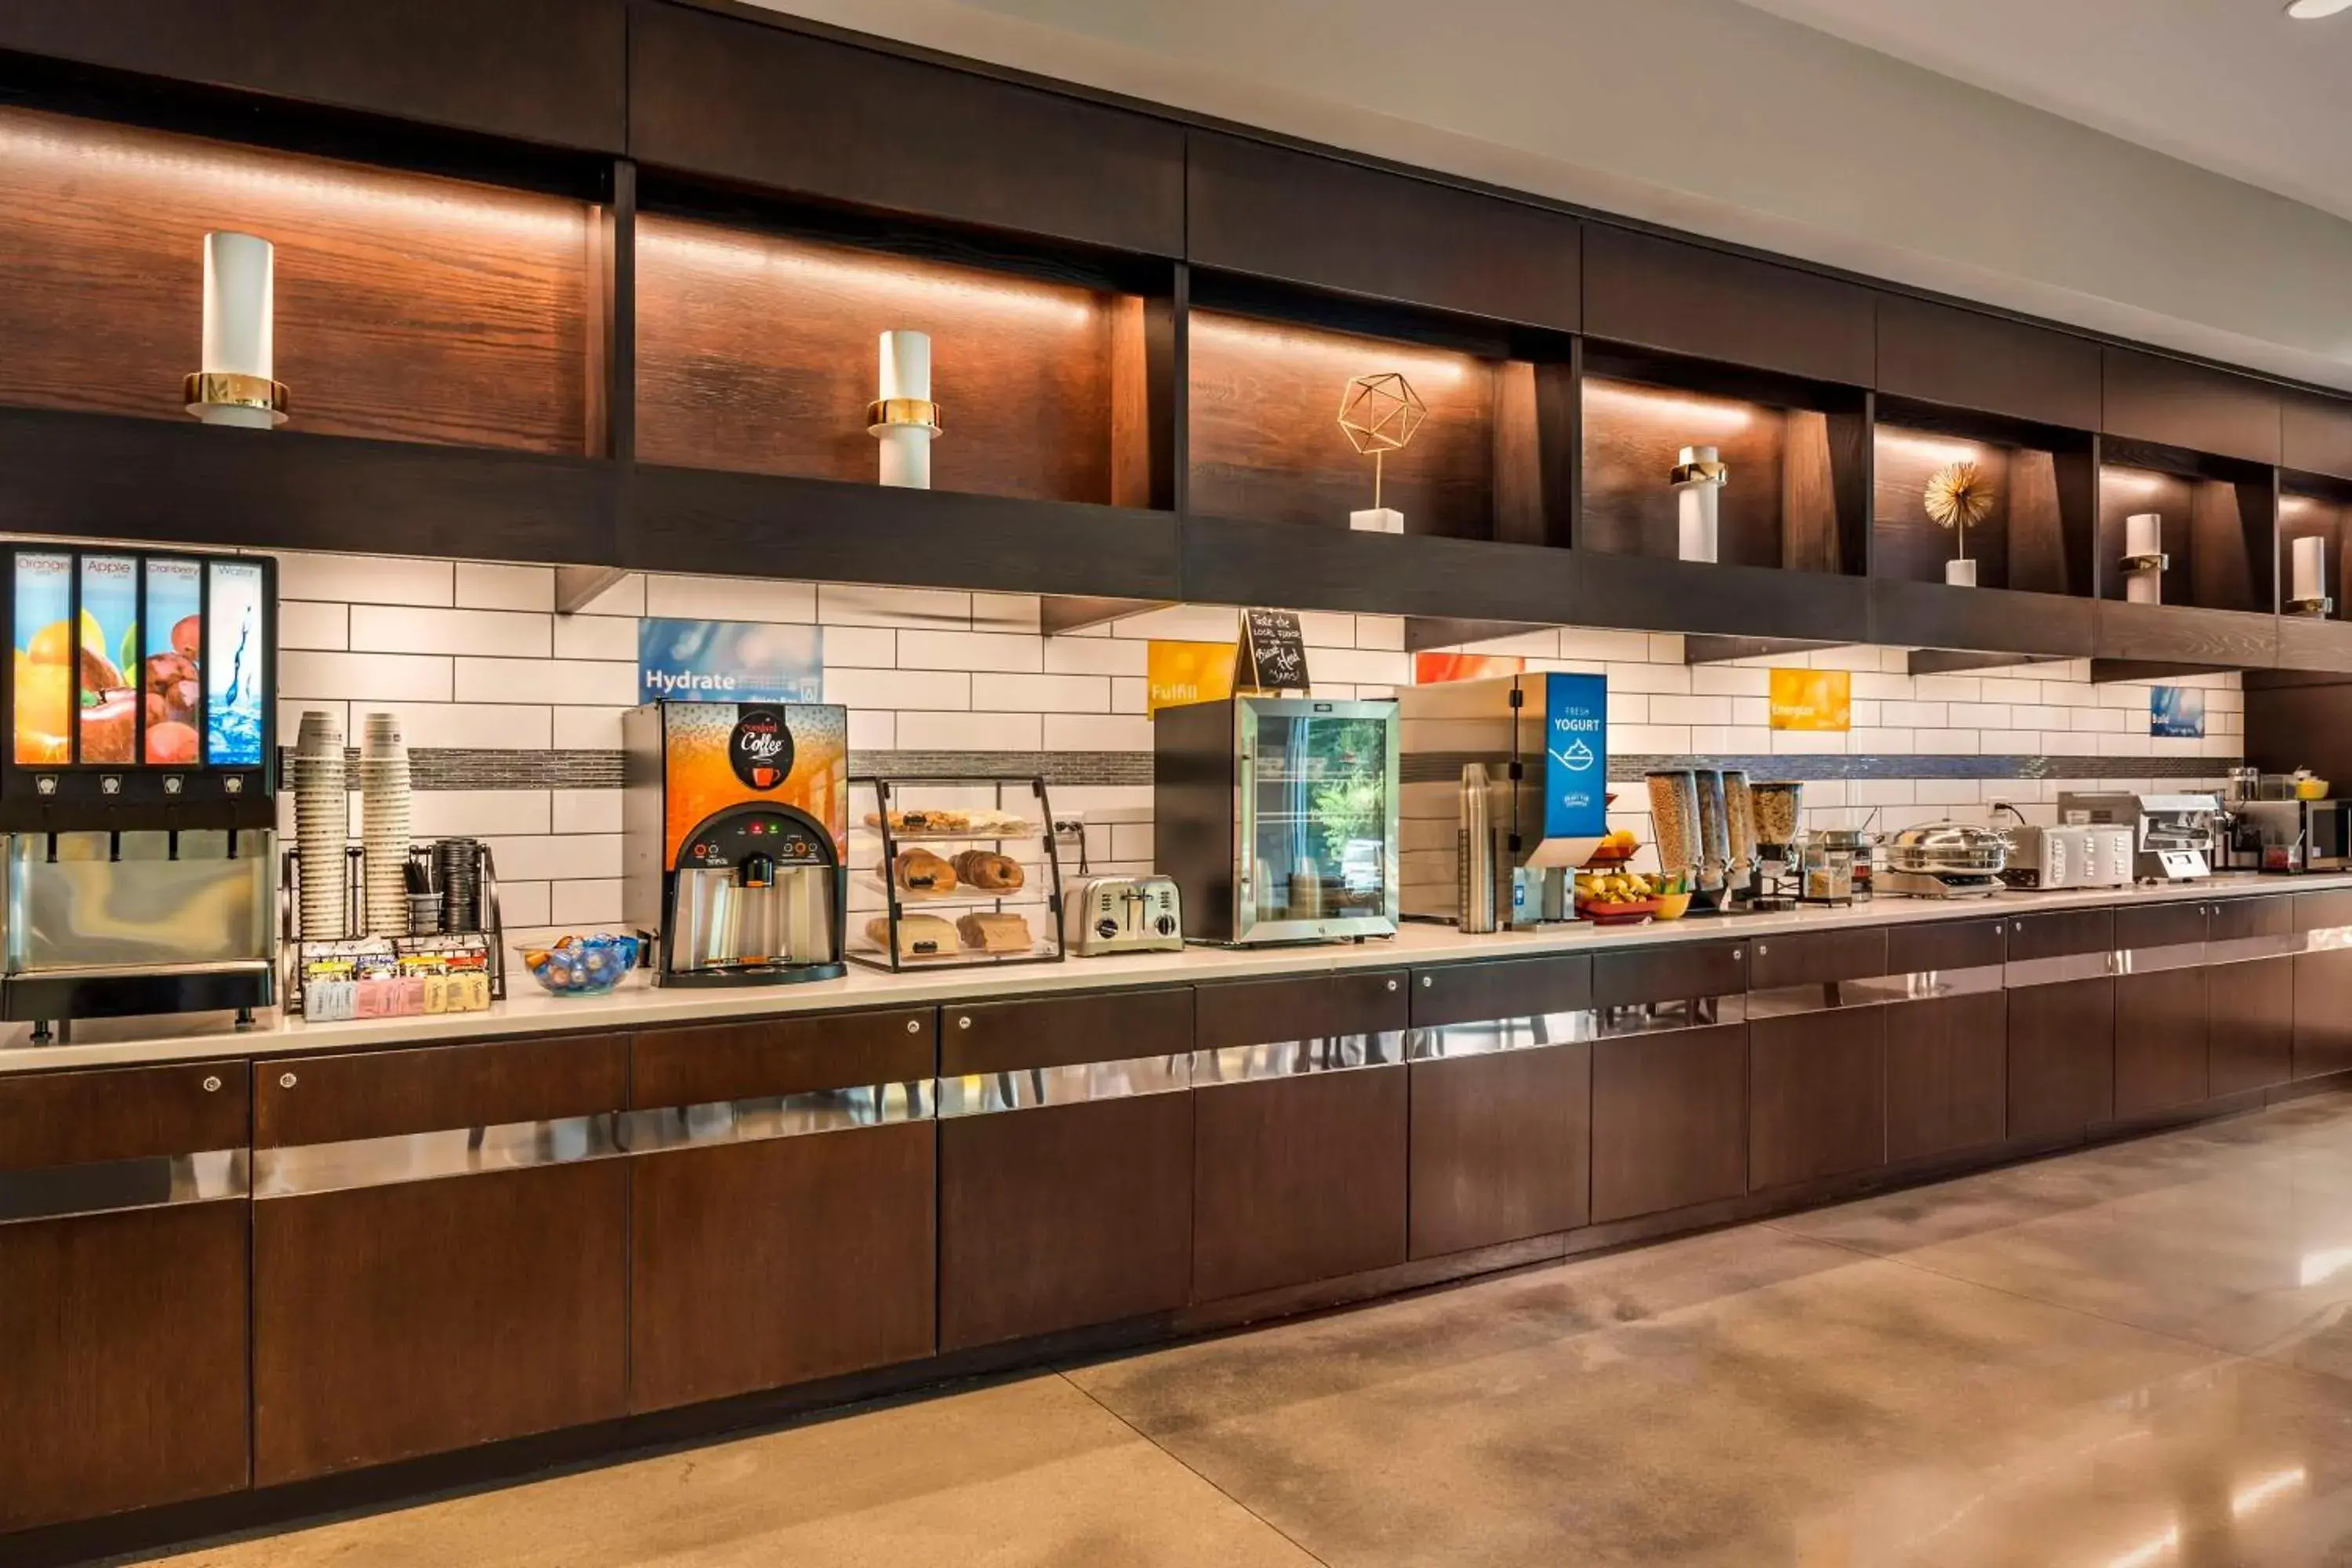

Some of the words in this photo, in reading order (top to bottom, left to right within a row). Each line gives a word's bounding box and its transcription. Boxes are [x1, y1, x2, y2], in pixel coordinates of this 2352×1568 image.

[88, 560, 131, 574] Apple
[645, 669, 735, 693] Hydrate
[1152, 684, 1197, 700] Fulfill
[1555, 717, 1600, 731] YOGURT
[741, 731, 782, 755] Coffee
